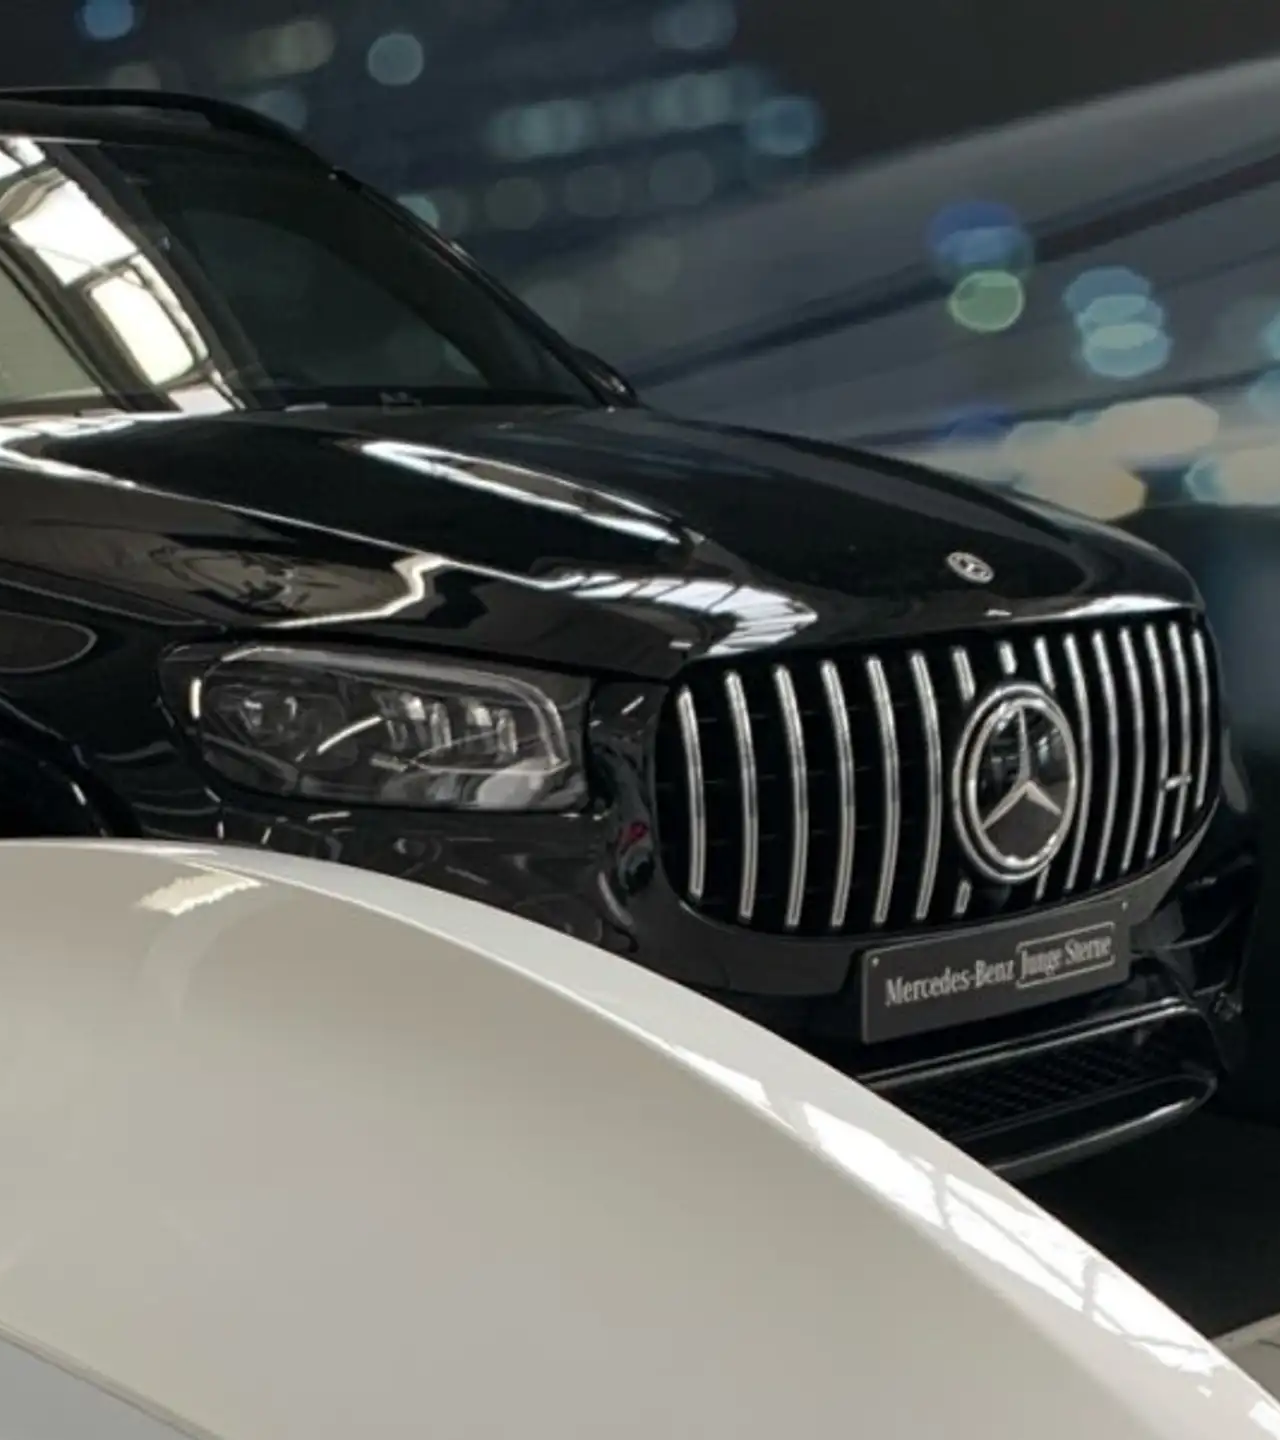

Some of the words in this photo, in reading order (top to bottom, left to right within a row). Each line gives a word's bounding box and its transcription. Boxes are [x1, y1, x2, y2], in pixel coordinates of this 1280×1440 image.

[885, 959, 1016, 1006] Mercedes-Benz
[1021, 950, 1063, 979] Junge
[1065, 936, 1112, 965] Sterne
